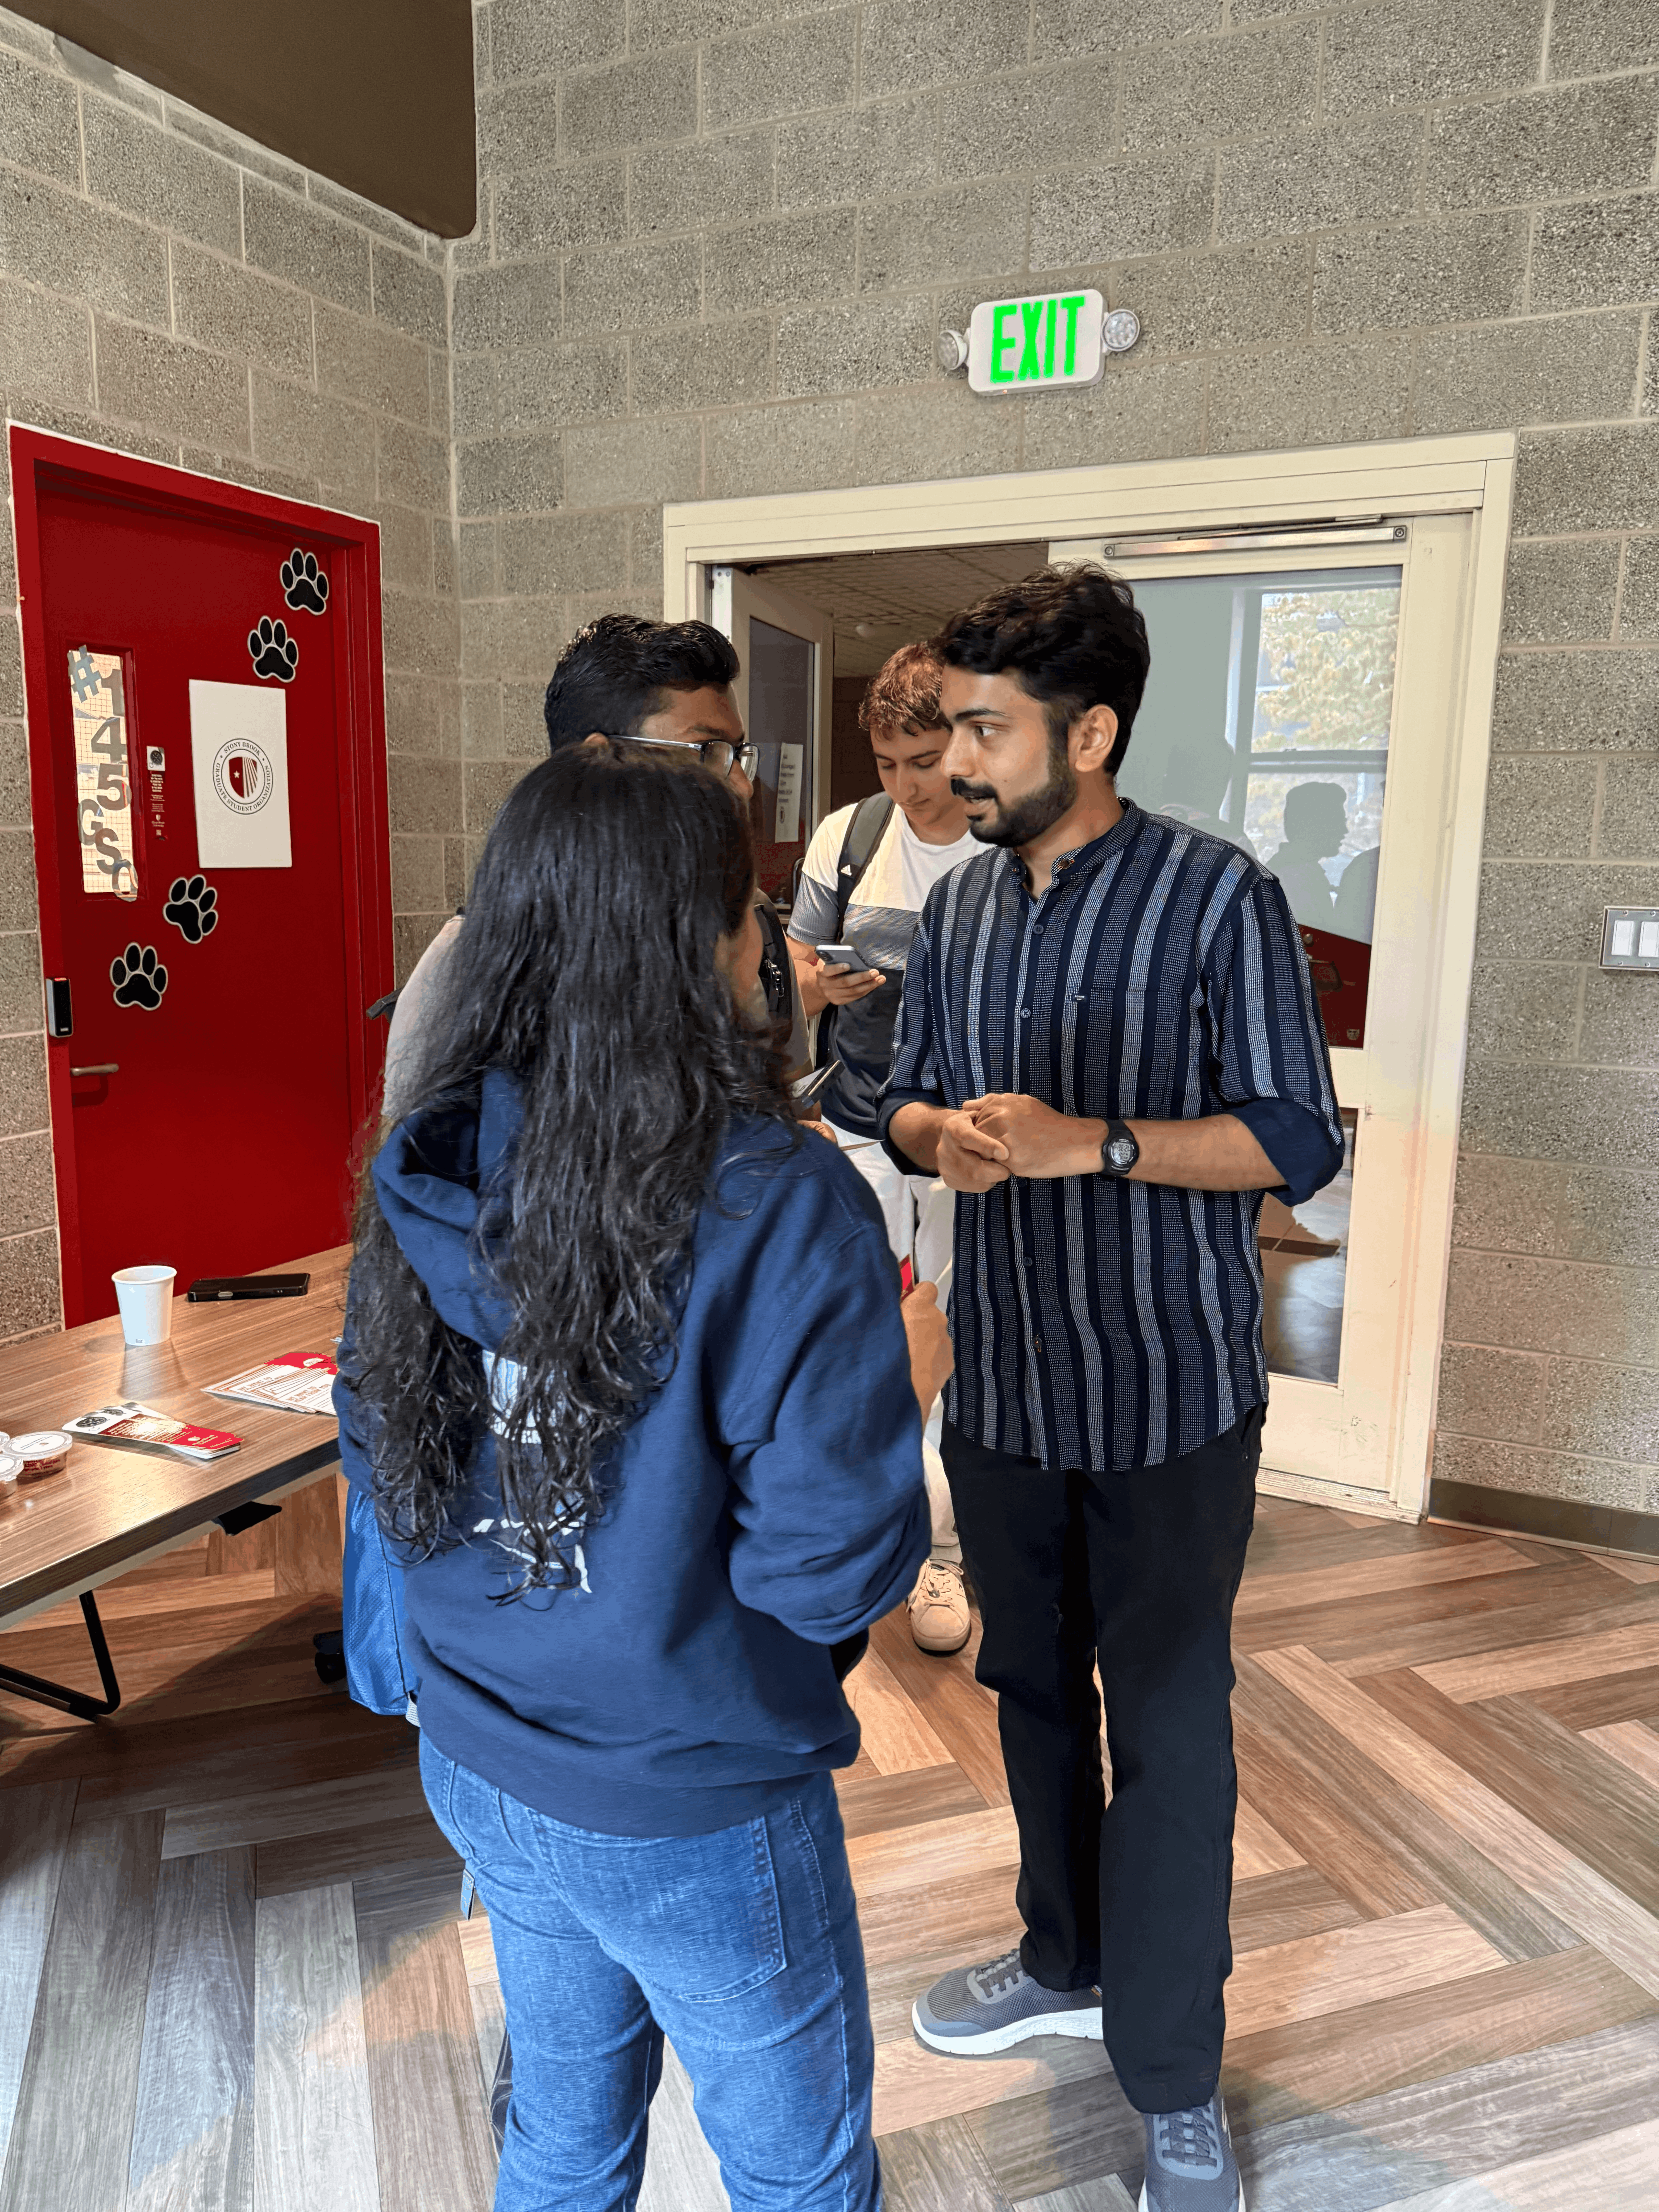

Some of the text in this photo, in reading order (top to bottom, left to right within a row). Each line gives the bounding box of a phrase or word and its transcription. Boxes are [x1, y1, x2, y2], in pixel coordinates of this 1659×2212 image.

[990, 296, 1085, 384] EXIT
[224, 742, 261, 756] STONY BROOK
[215, 763, 271, 812] GRADUATE STUDENT ORGANIZATION
[77, 799, 139, 902] GSO
